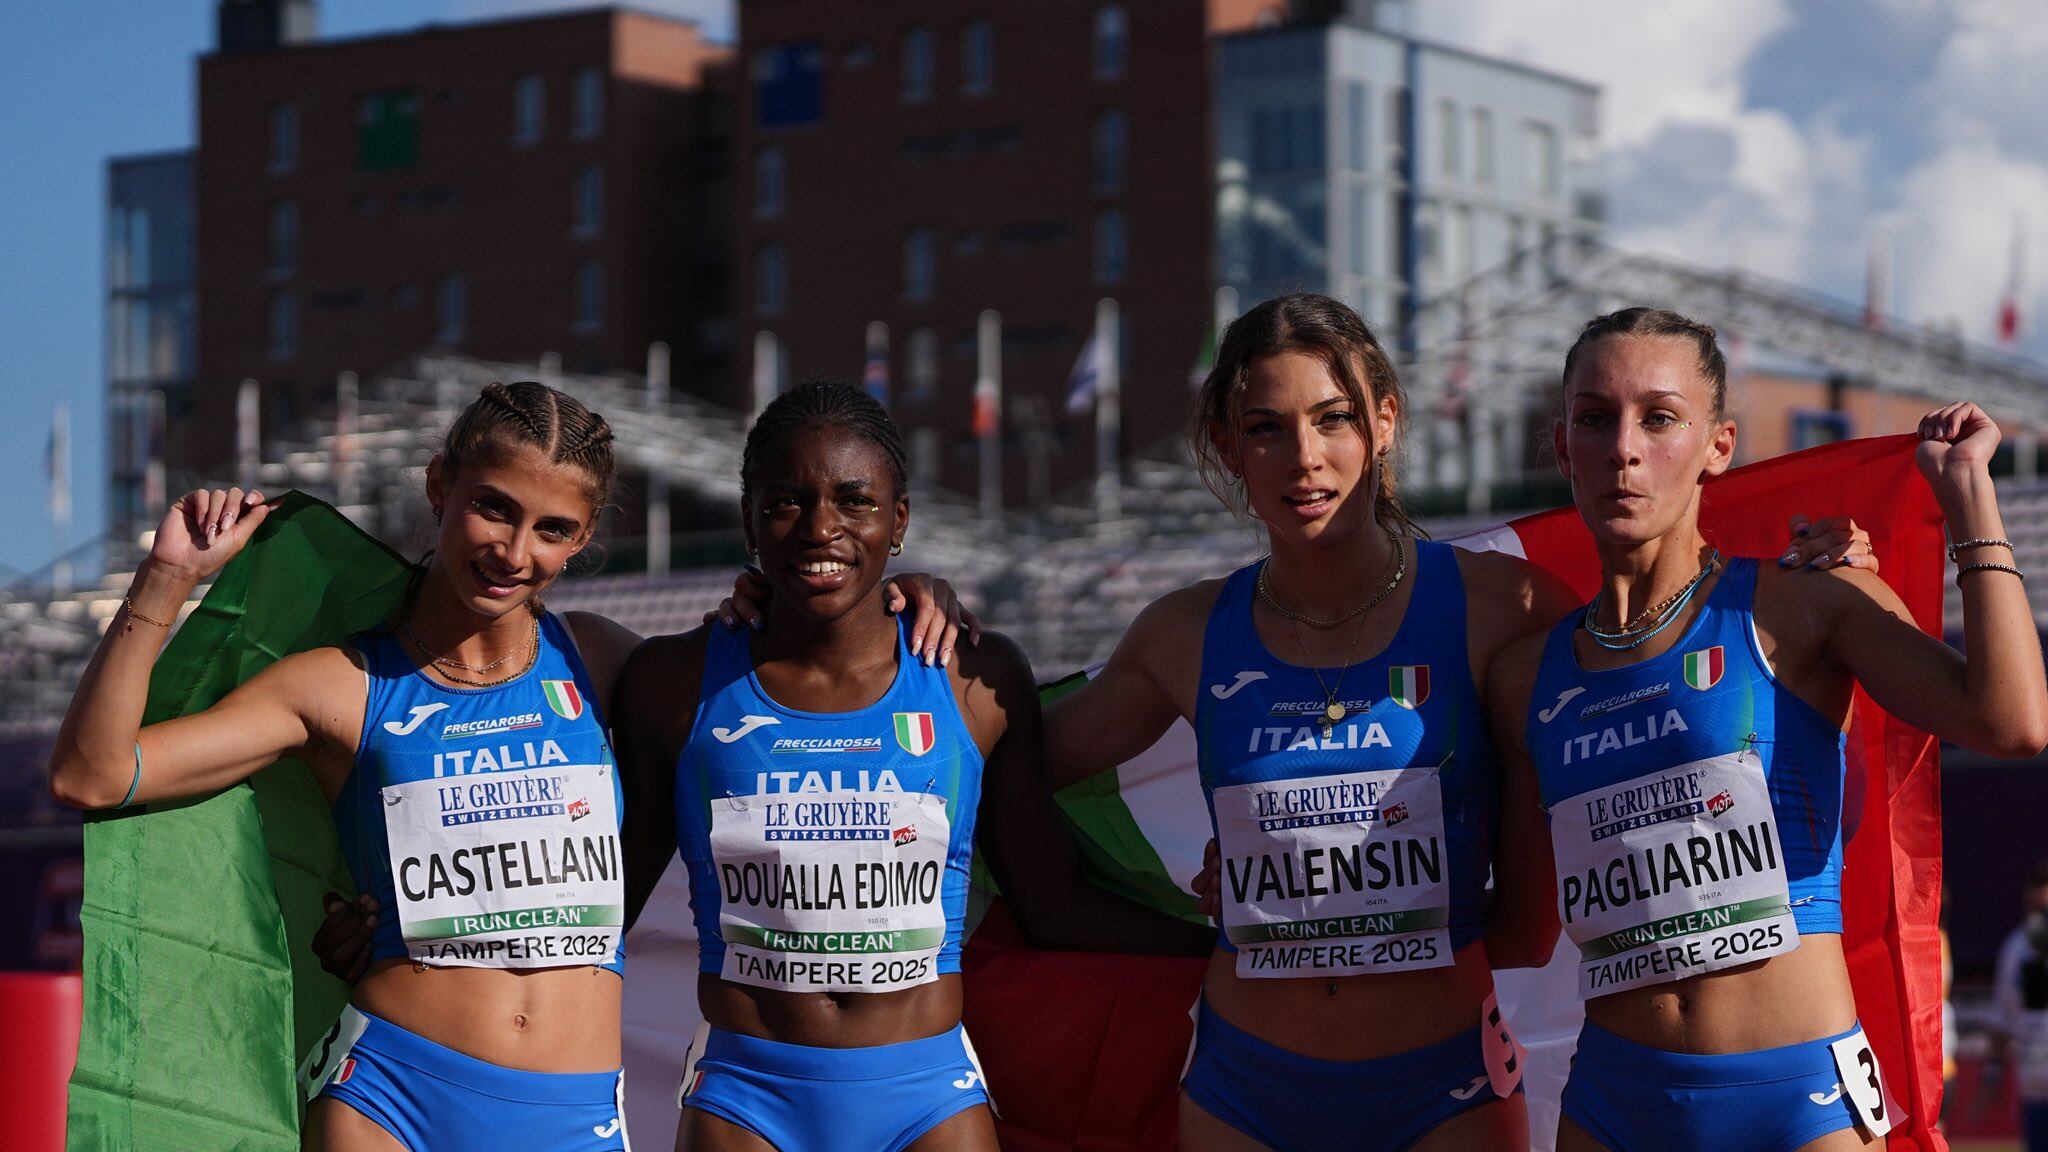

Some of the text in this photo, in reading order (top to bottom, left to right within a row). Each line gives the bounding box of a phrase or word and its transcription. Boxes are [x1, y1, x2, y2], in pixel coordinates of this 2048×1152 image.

[1271, 700, 1371, 711] FRECCIAOSSA
[1580, 682, 1670, 717] FRECCIAROSSA
[443, 713, 543, 735] FRECCIAROSSA
[1249, 722, 1393, 752] ITALIA
[1563, 709, 1688, 765] ITALIA
[773, 737, 881, 749] FRECCIAROSSA
[433, 740, 569, 778] ITALIA
[756, 770, 904, 796] ITALIA
[438, 787, 465, 812] LE
[1256, 791, 1281, 818] LE
[1710, 797, 1732, 813] AOP
[447, 804, 560, 825] SWITZERLAND
[765, 804, 789, 827] LE
[1264, 811, 1374, 831] SWITZERLAND
[1586, 799, 1606, 827] LE
[1596, 804, 1699, 839] SWITZERLAND
[770, 830, 885, 840] SWITZERLAND
[400, 835, 618, 902] CASTELLANI
[1226, 837, 1442, 904] VALENSIN
[1563, 821, 1777, 924] PAGLIARINI
[721, 860, 939, 911] DOUALLA EDIMO
[453, 917, 460, 934] I
[465, 914, 511, 932] RUN
[1268, 925, 1274, 939] I
[1278, 921, 1319, 938] RUN
[422, 935, 610, 960] TAMPERE 2025
[763, 931, 769, 947] I
[773, 931, 818, 951] RUN
[1609, 936, 1616, 950] I
[1617, 927, 1655, 948] RUN
[1249, 937, 1437, 969] TAMPERE 2025
[1587, 924, 1783, 989] TAMPERE 2025
[734, 952, 929, 985] TAMPERE 2025
[1857, 1047, 1884, 1121] 3
